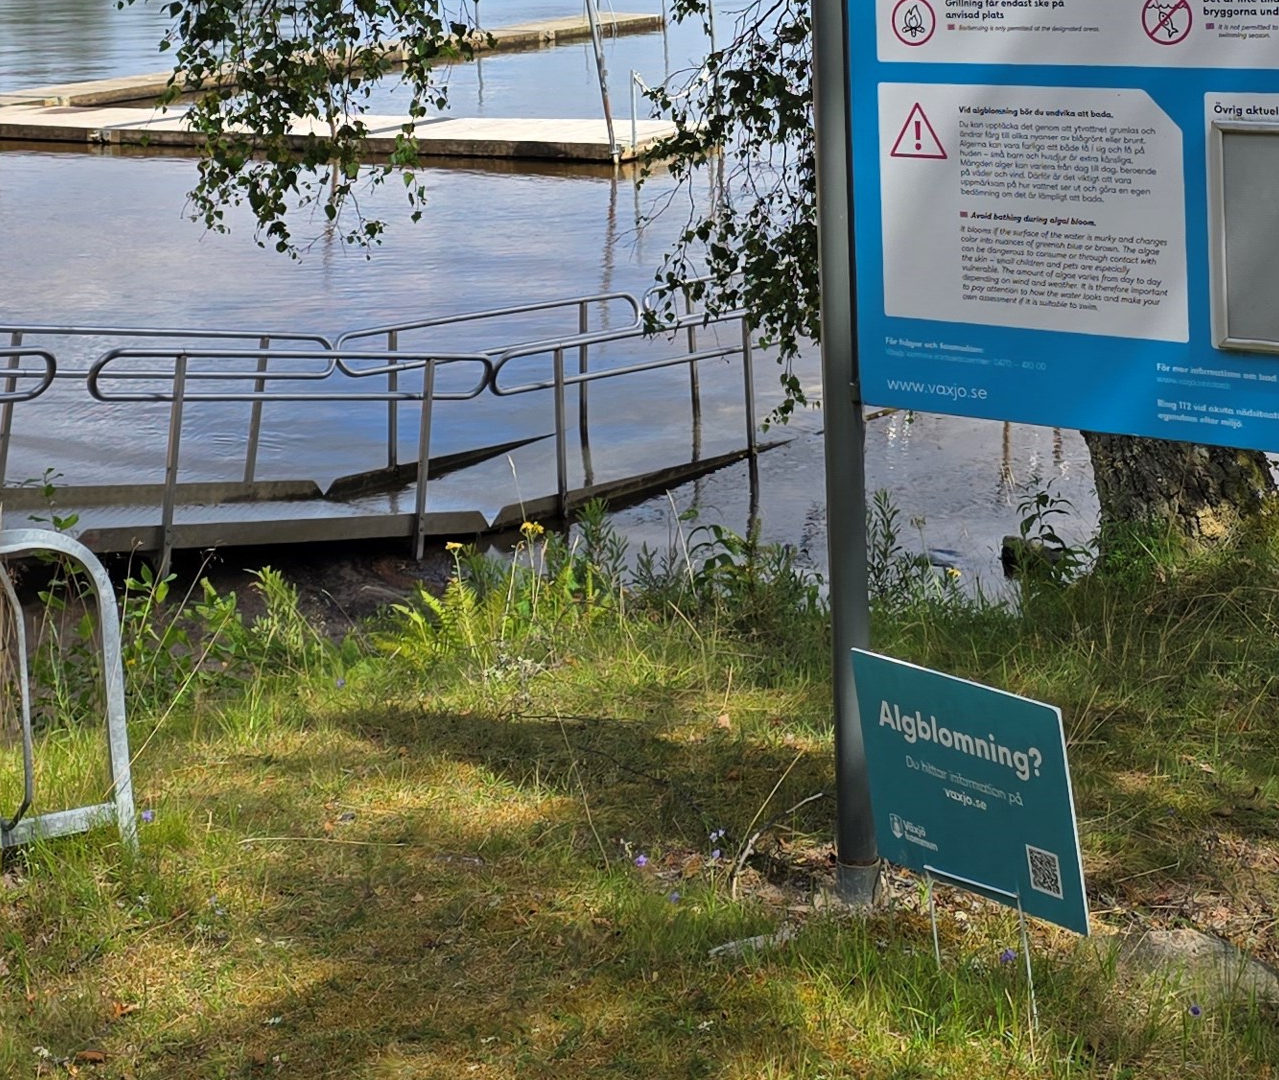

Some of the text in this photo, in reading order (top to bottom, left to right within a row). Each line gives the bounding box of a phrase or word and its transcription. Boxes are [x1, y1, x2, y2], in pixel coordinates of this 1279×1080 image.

[1001, 0, 1031, 7] endast
[1035, 0, 1049, 7] ske
[946, 11, 1004, 20] anvisad plats
[1203, 7, 1257, 17] bryggorna
[1046, 109, 1075, 117] undvika
[1091, 110, 1113, 118] bada.
[1214, 102, 1242, 116] Övrig
[1024, 215, 1047, 225] during
[1156, 363, 1170, 372] För
[887, 379, 987, 400] www.vaxjo.se
[1180, 401, 1191, 411] 112
[1194, 403, 1206, 412] vid
[879, 700, 1042, 781] Algblomning?
[906, 755, 919, 769] Du
[1008, 792, 1023, 806] på
[943, 788, 987, 810] vaxjo.se
